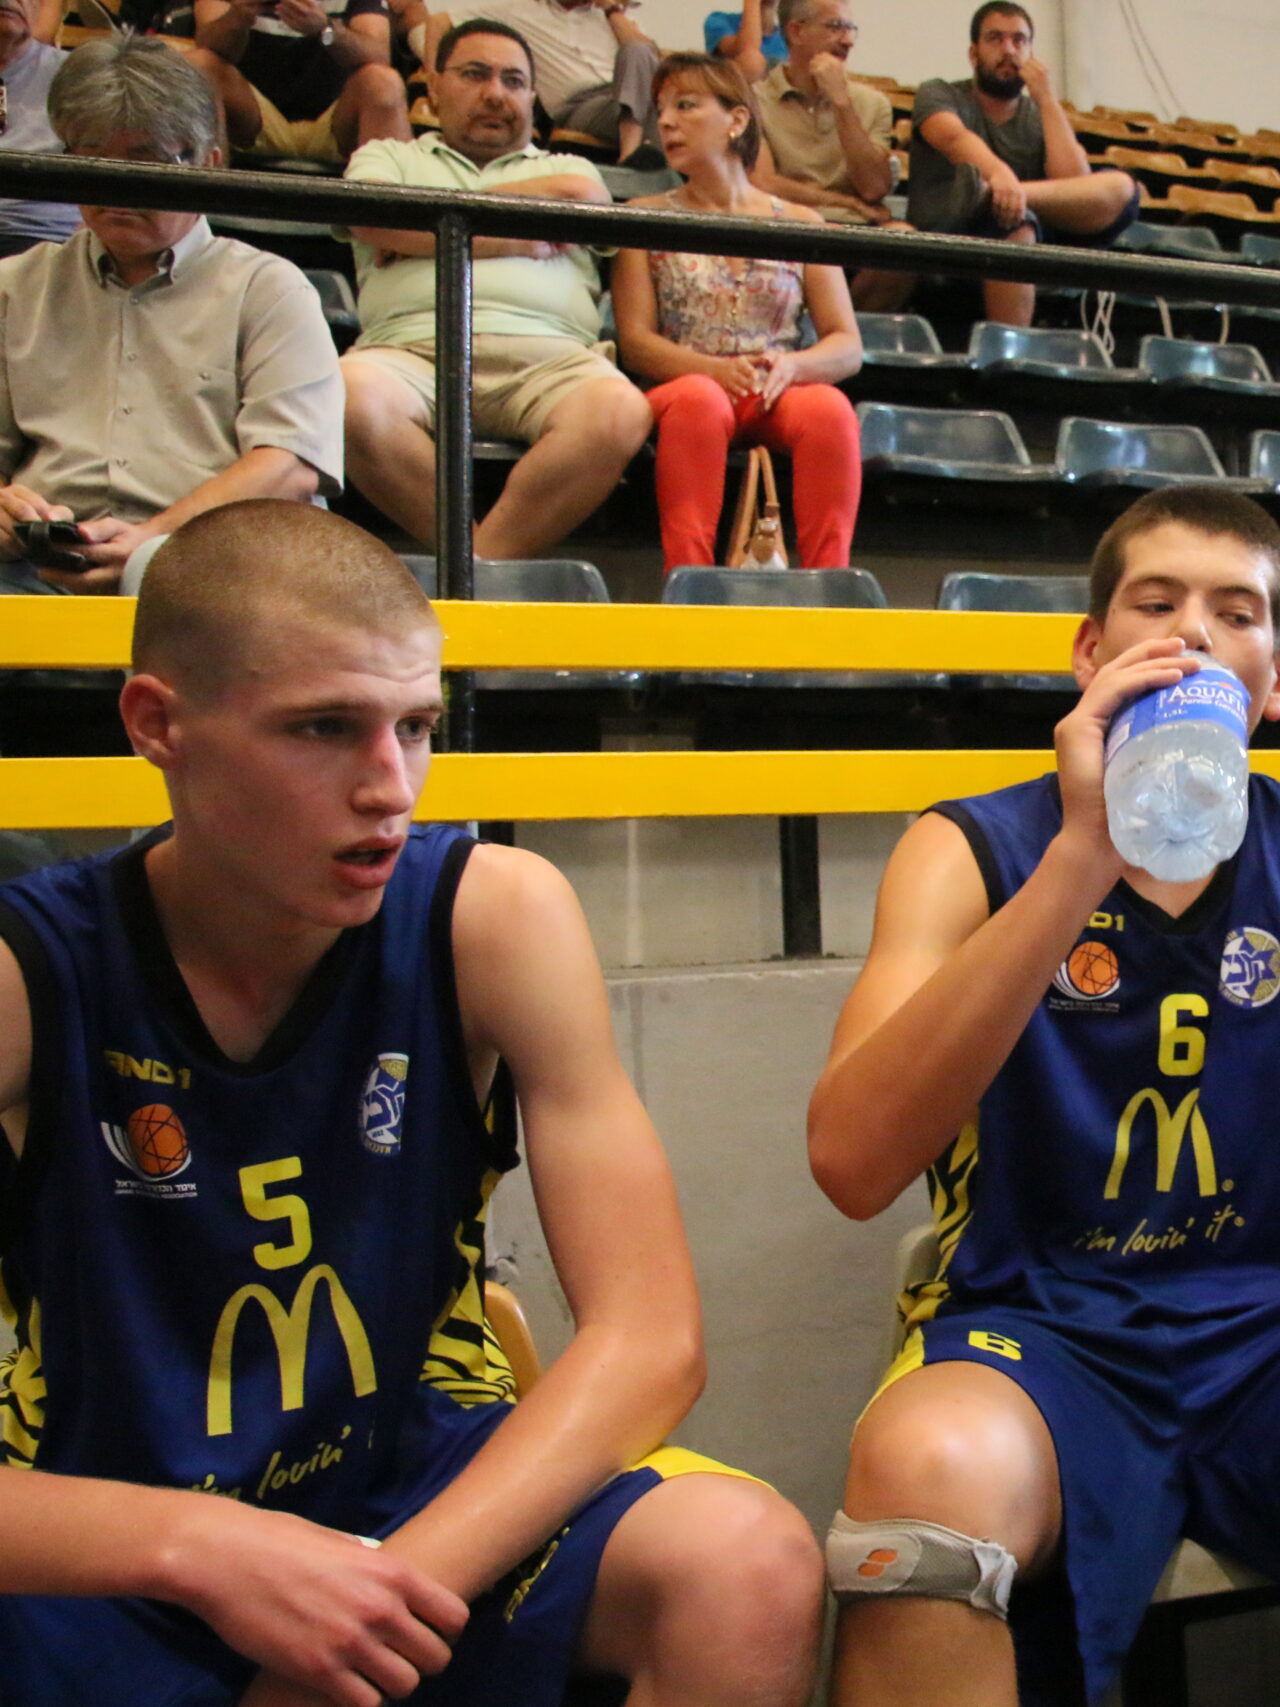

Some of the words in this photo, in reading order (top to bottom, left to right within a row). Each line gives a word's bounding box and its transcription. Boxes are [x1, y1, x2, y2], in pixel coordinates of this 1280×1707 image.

[1158, 994, 1209, 1076] 6
[1103, 1087, 1217, 1200] M
[239, 1156, 312, 1271] 5
[1121, 1218, 1195, 1256] lovin'
[207, 1264, 377, 1436] M
[968, 1330, 1022, 1361] 6
[257, 1425, 352, 1499] lovin'
